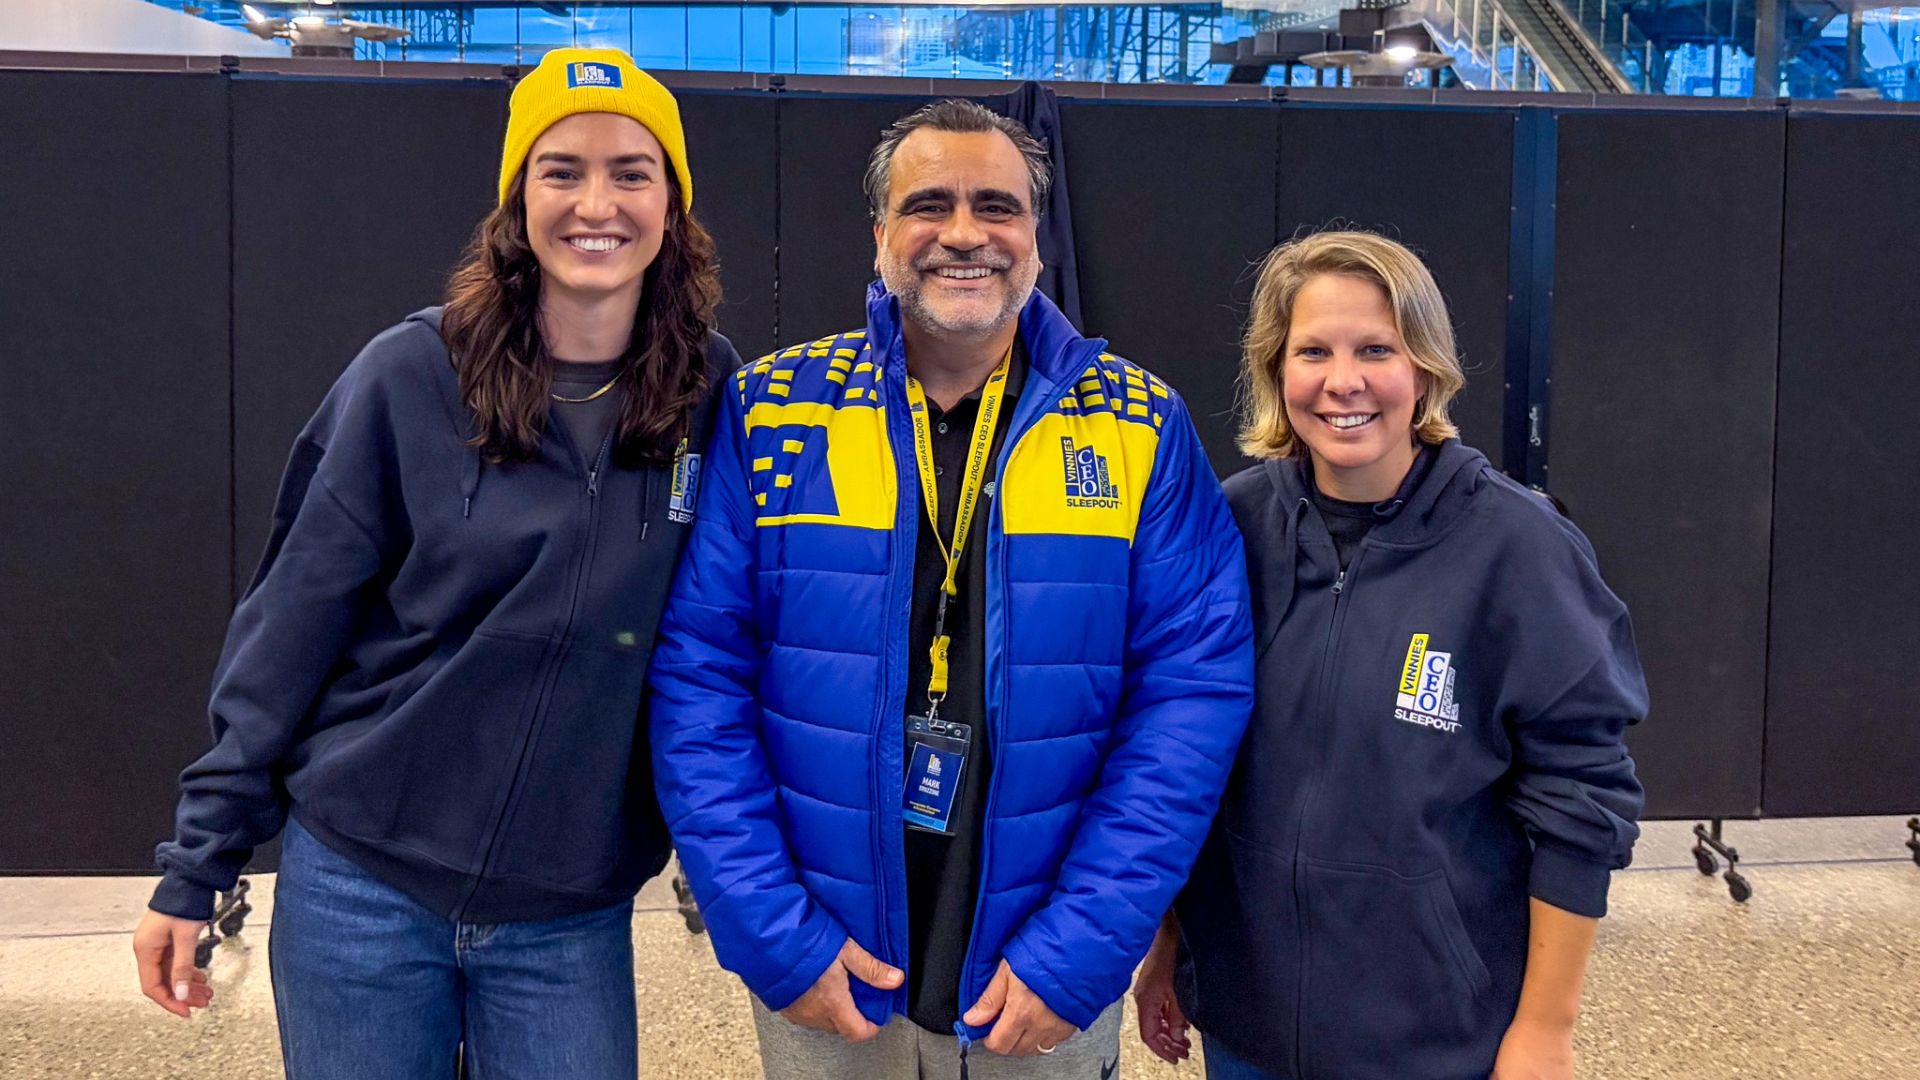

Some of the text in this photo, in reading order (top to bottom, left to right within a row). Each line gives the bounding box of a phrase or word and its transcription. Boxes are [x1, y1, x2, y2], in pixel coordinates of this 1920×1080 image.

[983, 395, 996, 423] VINNIES
[915, 417, 930, 472] AMBASSADOR
[978, 424, 990, 441] CEO
[971, 441, 985, 481] SLEEPOUT
[1063, 439, 1077, 482] VINNIES
[1077, 449, 1098, 496] CEO
[684, 457, 699, 510] CEO
[1066, 498, 1119, 509] SLEEPOUT
[957, 486, 974, 544] AMBASSADOR
[1403, 638, 1424, 690] VINNIES
[1419, 655, 1446, 711] CEO
[1393, 708, 1457, 733] SLEEPOUT
[921, 777, 941, 790] MARK
